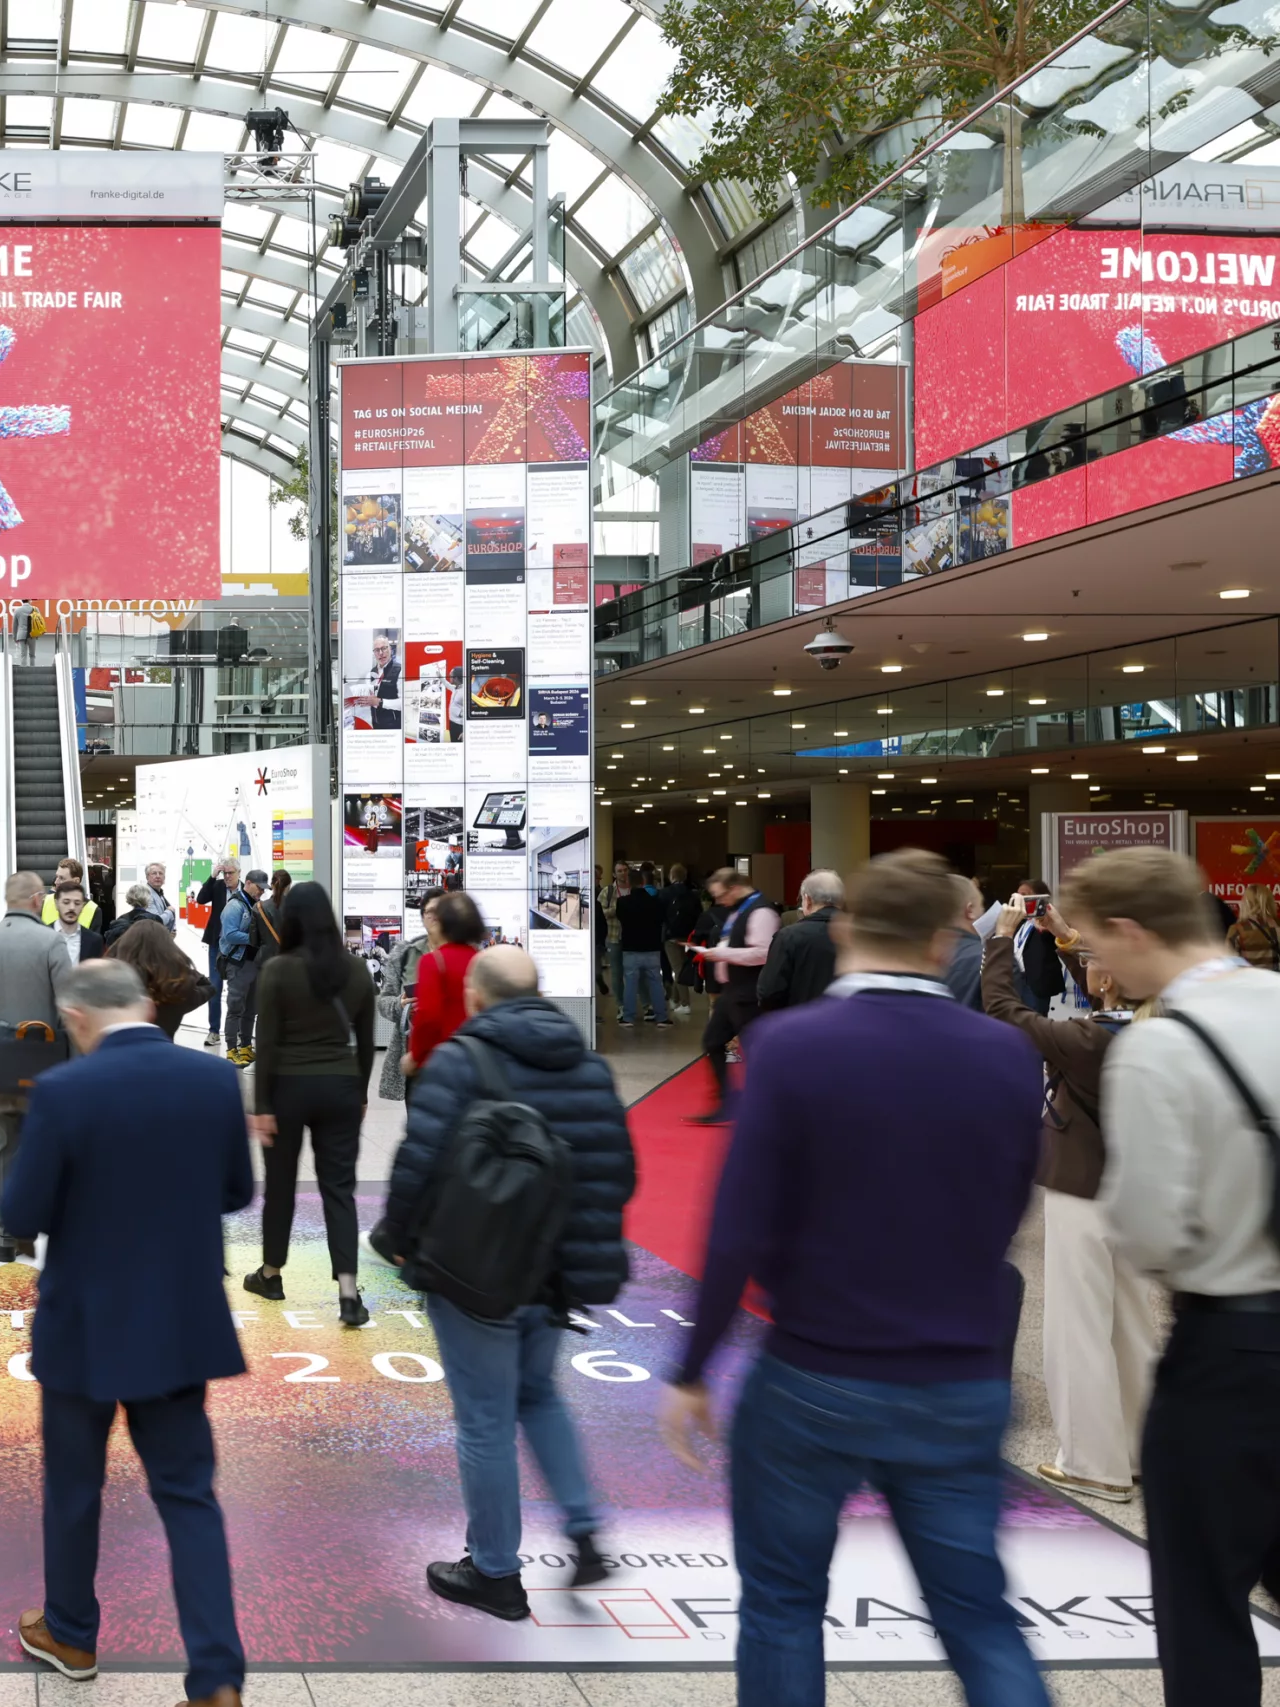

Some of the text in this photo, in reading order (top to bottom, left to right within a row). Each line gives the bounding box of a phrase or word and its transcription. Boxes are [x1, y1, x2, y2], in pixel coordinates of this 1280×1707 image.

[90, 189, 165, 200] franke-digital.de
[22, 291, 77, 309] TRADE
[83, 291, 122, 309] FAIR
[353, 404, 483, 419] TAG US ON SOCIAL MEDIA!
[354, 427, 425, 439] #EUROSHOP26
[354, 439, 435, 452] #RETAILFESTIVAL
[467, 542, 523, 554] EUROSHOP
[1064, 819, 1165, 838] EuroShop
[271, 1350, 651, 1383] 206
